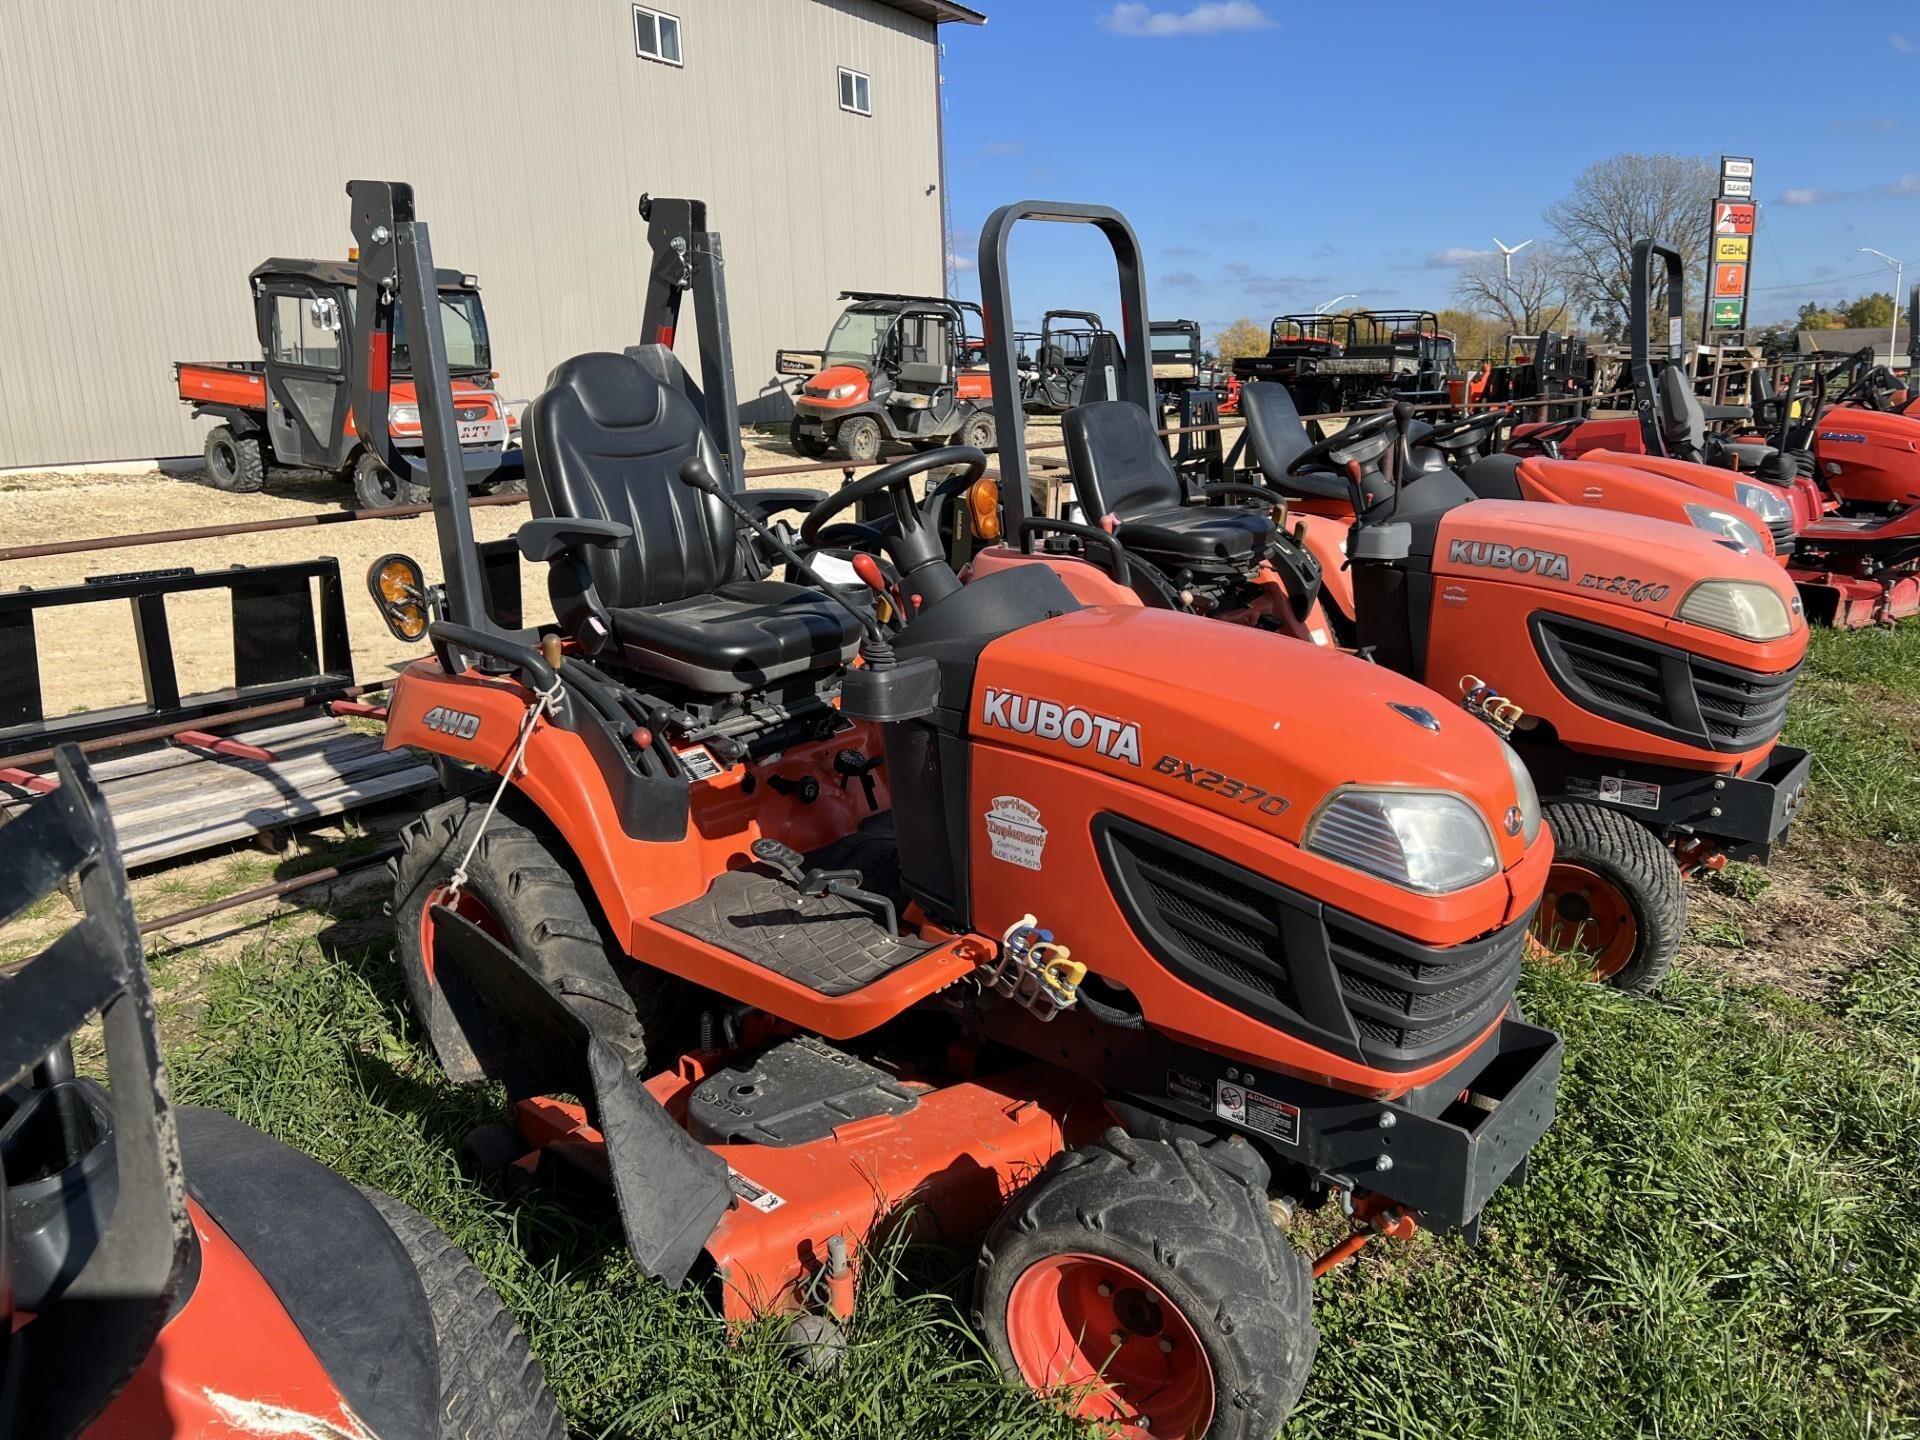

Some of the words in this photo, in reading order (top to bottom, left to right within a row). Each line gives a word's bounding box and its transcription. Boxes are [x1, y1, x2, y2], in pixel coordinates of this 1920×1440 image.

[1721, 213, 1753, 225] AGCO
[1720, 244, 1747, 255] GEHL
[1449, 539, 1570, 581] KUBOTA
[1577, 573, 1670, 603] BX2360
[422, 705, 481, 740] 4WD
[983, 688, 1142, 767] KUBOTA
[1151, 755, 1292, 816] BX2370
[992, 798, 1040, 821] Portland
[989, 822, 1044, 847] Implement
[1024, 847, 1035, 857] WI
